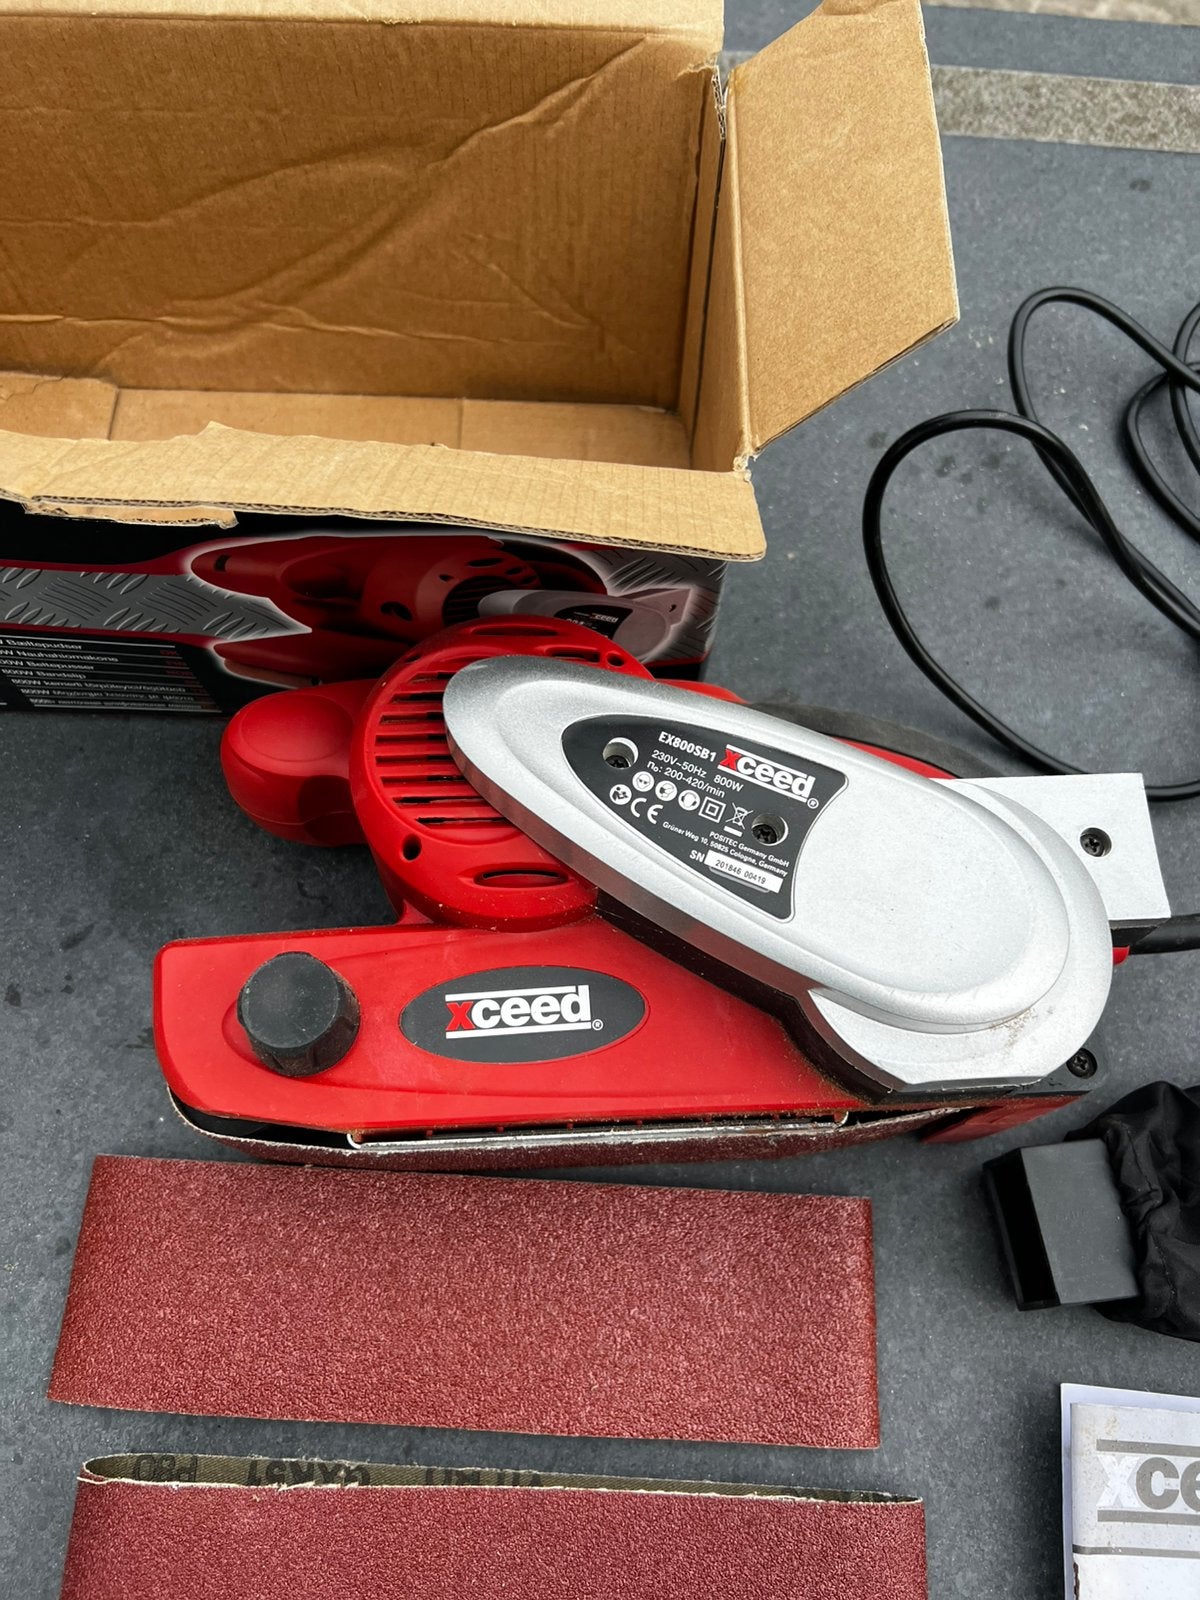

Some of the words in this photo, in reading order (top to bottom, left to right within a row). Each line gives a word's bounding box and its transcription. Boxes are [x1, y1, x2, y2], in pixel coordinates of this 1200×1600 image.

[658, 731, 717, 762] EX800SB1
[651, 749, 707, 778] 230V~50Hz
[713, 774, 744, 793] 800W
[664, 767, 726, 798] 200-420/min
[718, 749, 816, 797] xceed
[662, 821, 685, 836] Grüner
[685, 830, 699, 844] Weg
[729, 847, 758, 867] Cologne,
[758, 859, 788, 877] Germany
[689, 849, 705, 863] SN
[709, 831, 738, 847] POSITEC
[738, 843, 768, 860] Germany
[768, 853, 790, 868] GmbH
[715, 859, 742, 875] 201846
[743, 869, 767, 885] 00419
[445, 985, 592, 1031] xceed
